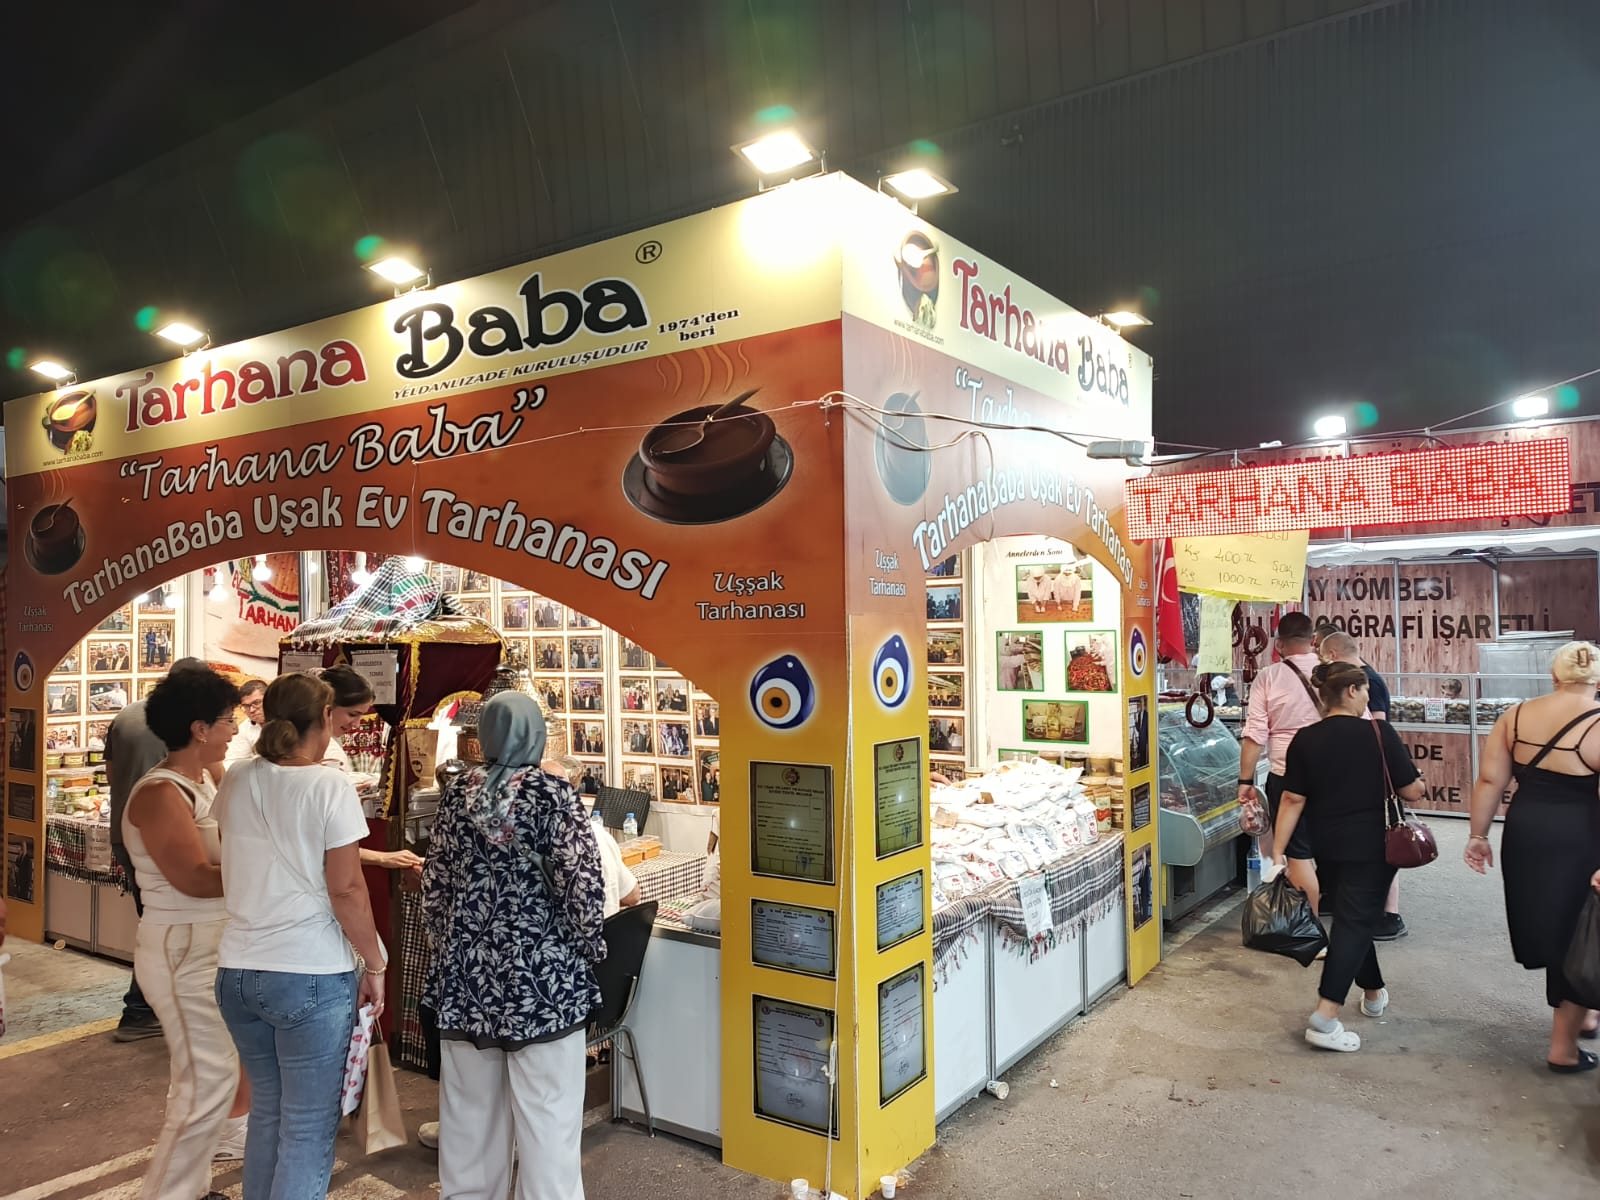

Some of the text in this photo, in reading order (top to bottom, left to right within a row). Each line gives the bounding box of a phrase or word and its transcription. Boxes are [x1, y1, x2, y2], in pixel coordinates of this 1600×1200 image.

[658, 309, 740, 335] 1974'den
[679, 325, 716, 342] beri
[953, 259, 1130, 408] Tarhana Baba
[116, 272, 648, 432] Tarhana Baba
[393, 339, 649, 399] YELDANLIZADE KURULUŞUDUR
[1133, 473, 1370, 525] TARHANA
[1390, 454, 1543, 508] BABA
[1029, 462, 1065, 507] Uşak
[1085, 485, 1135, 593] Tarhanası
[63, 486, 670, 614] TarhanaBaba Uşak Ev Tarhanası
[1215, 547, 1240, 565] 400
[713, 570, 785, 594] Uşşak
[869, 576, 906, 597] Tarhanası
[1218, 571, 1244, 585] 1000
[696, 601, 806, 621] Tarhanası
